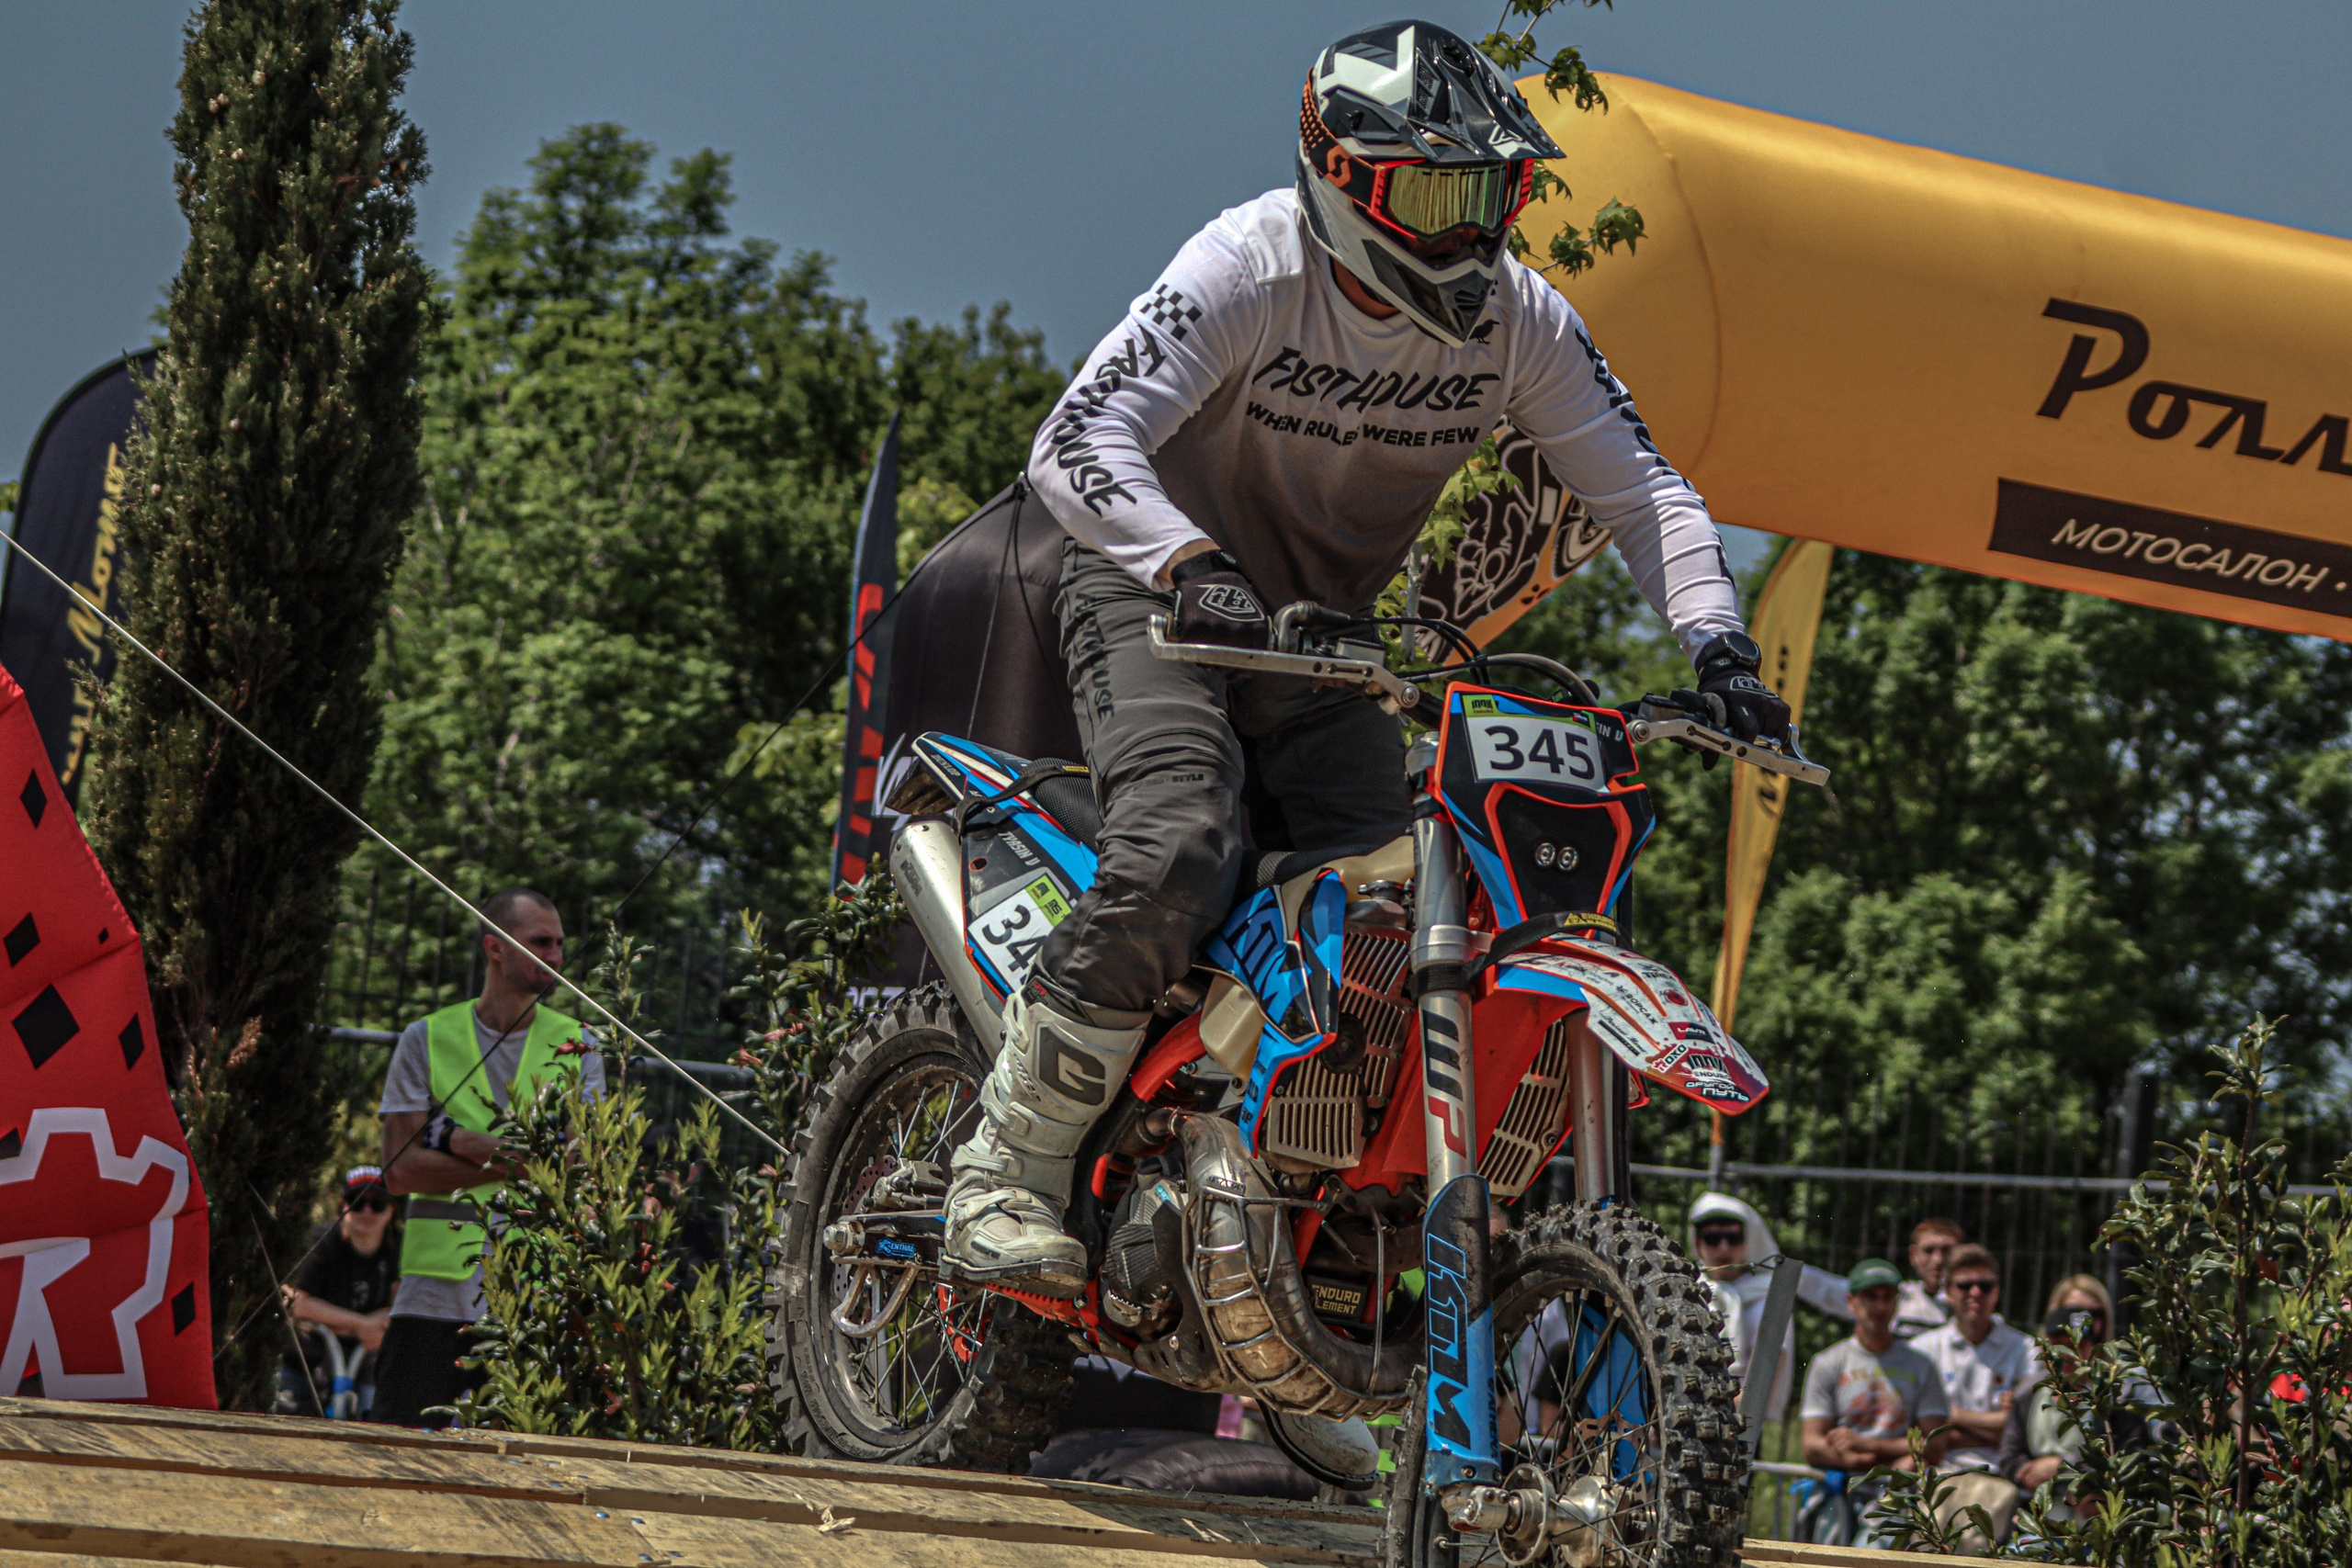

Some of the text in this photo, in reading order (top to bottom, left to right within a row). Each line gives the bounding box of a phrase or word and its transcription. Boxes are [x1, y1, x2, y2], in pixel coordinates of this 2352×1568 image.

[1303, 420, 1360, 446] RULE
[1363, 423, 1427, 447] WERE
[1430, 426, 1480, 446] FEW
[2051, 518, 2331, 593] МОТОСАЛОН
[931, 753, 961, 777] DUNLOP
[1484, 725, 1596, 780] 345
[998, 830, 1034, 861] TYASIN
[981, 904, 1047, 986] 34
[1702, 1088, 1750, 1102] ПУТЬ
[1316, 1300, 1357, 1314] LEMENT
[1427, 1233, 1471, 1450] KTM
